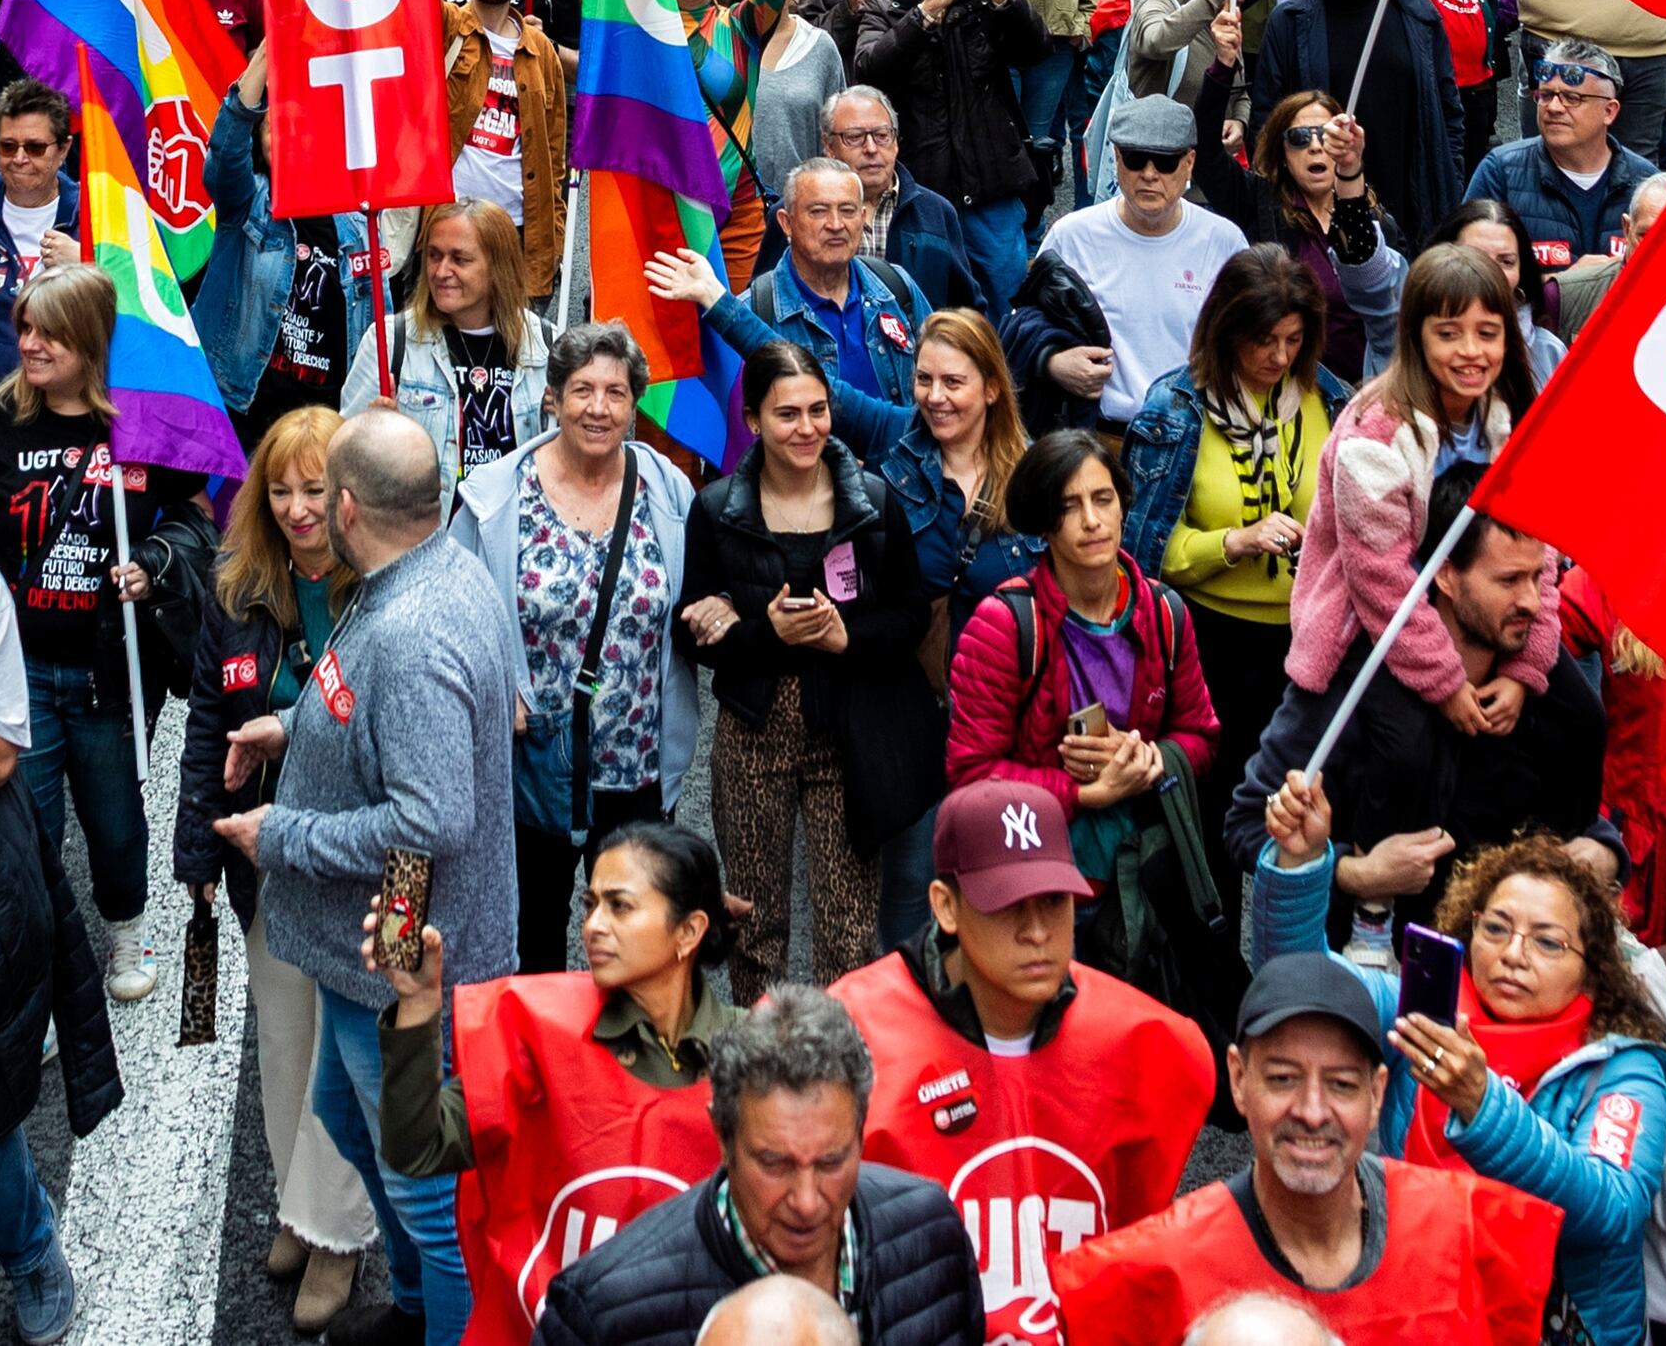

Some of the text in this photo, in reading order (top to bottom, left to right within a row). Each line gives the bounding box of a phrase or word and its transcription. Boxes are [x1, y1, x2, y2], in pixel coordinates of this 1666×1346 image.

[472, 134, 490, 145] UGT
[18, 449, 62, 472] UGT
[49, 545, 109, 562] RESENTE Y
[42, 558, 85, 575] FUTURO
[42, 575, 62, 591] TUS
[27, 587, 97, 610] DEFIEND
[317, 653, 340, 699] UGT
[1000, 802, 1042, 850] NY
[917, 1068, 971, 1104] ÚNETE
